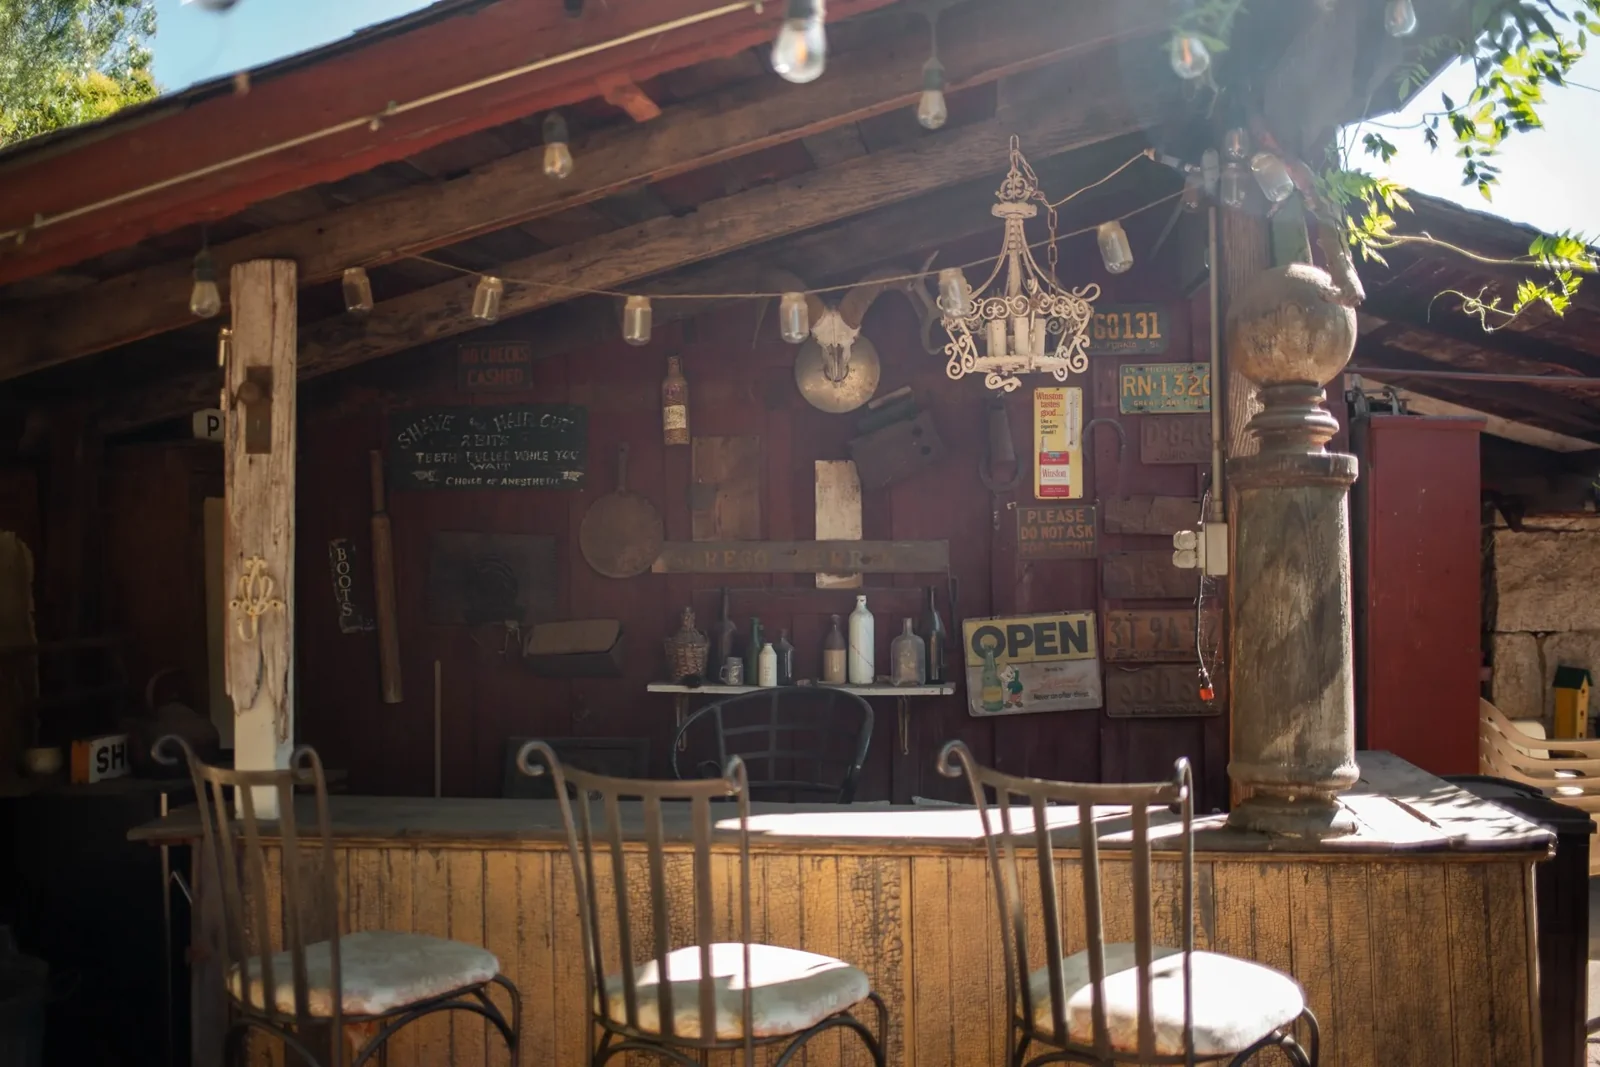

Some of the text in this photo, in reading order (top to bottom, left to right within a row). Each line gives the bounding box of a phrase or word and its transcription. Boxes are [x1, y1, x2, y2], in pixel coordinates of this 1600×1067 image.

[467, 368, 524, 386] CASHED
[1036, 392, 1064, 400] Winston
[397, 413, 456, 450] SHAVE
[493, 412, 535, 433] HAIR
[539, 413, 575, 433] CUT
[461, 434, 511, 448] 2 BITS
[415, 449, 580, 464] TEETH PULLED WHILE YOU
[469, 462, 511, 471] WAIT
[1043, 467, 1067, 478] Winston
[1027, 509, 1085, 524] PLEASE
[1021, 524, 1093, 540] DO NOT ASK
[336, 547, 354, 618] BOOTS
[971, 620, 1089, 660] OPEN
[1034, 692, 1049, 700] Never
[96, 742, 125, 774] SH
